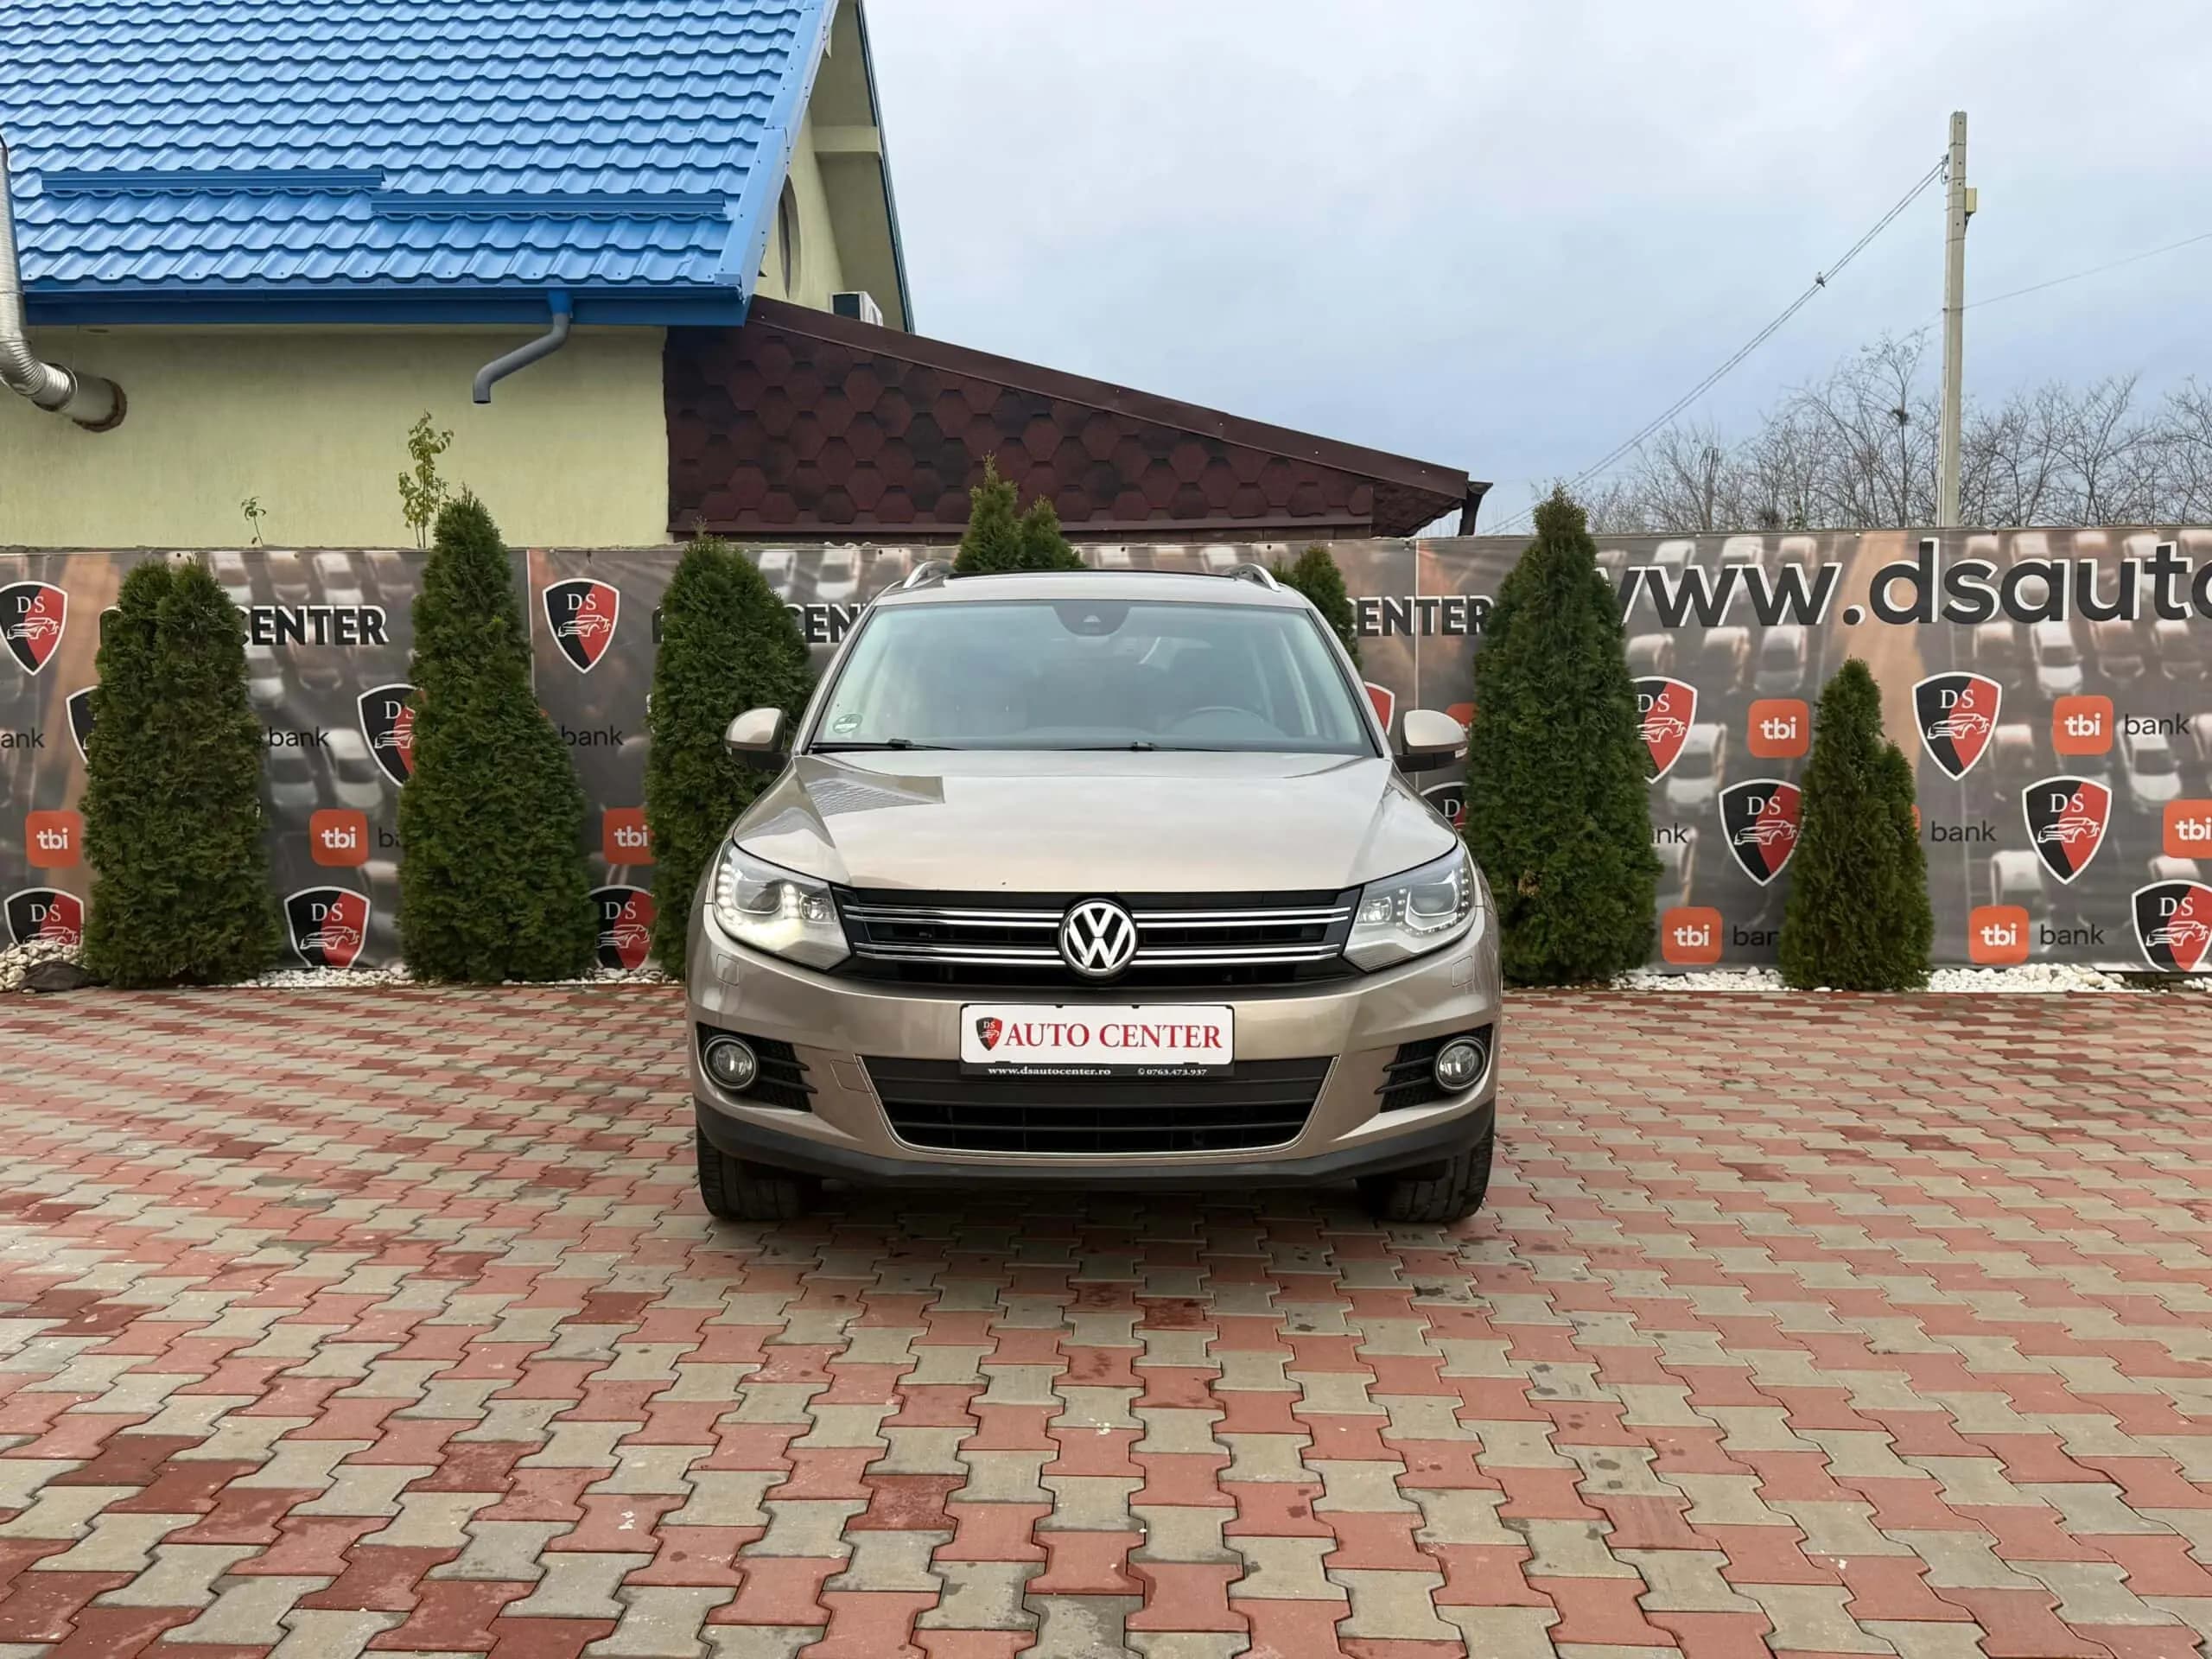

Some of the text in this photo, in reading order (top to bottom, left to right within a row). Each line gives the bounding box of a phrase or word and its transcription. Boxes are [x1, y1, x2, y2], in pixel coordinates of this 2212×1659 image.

[1594, 537, 2212, 627] ww.dsaut
[16, 596, 45, 613] DS
[567, 594, 596, 610] DS
[235, 605, 390, 645] ENTER
[1346, 595, 1495, 636] ENTER
[1637, 693, 1670, 713] DS
[1940, 690, 1974, 709] DS
[1759, 716, 1797, 740] tbi
[2064, 713, 2190, 736] tbi bank
[0, 728, 45, 748] ank
[269, 727, 330, 747] bank
[562, 726, 624, 747] bank
[1746, 796, 1781, 816] DS
[2050, 793, 2084, 813] DS
[36, 828, 68, 849] tbi
[321, 826, 356, 849] tbi
[613, 825, 648, 848] tbi
[1931, 821, 1997, 842] bank
[2175, 817, 2212, 841] tbi
[29, 904, 61, 922] DS
[310, 903, 344, 922] DS
[604, 901, 637, 920] DS
[2158, 897, 2194, 917] DS
[1673, 924, 1710, 947] tbi
[1980, 923, 2105, 947] tbi bank
[983, 1020, 995, 1029] DS
[1004, 1023, 1223, 1048] AUTO CENTER
[988, 1065, 1111, 1077] www.dsautocenter.ro
